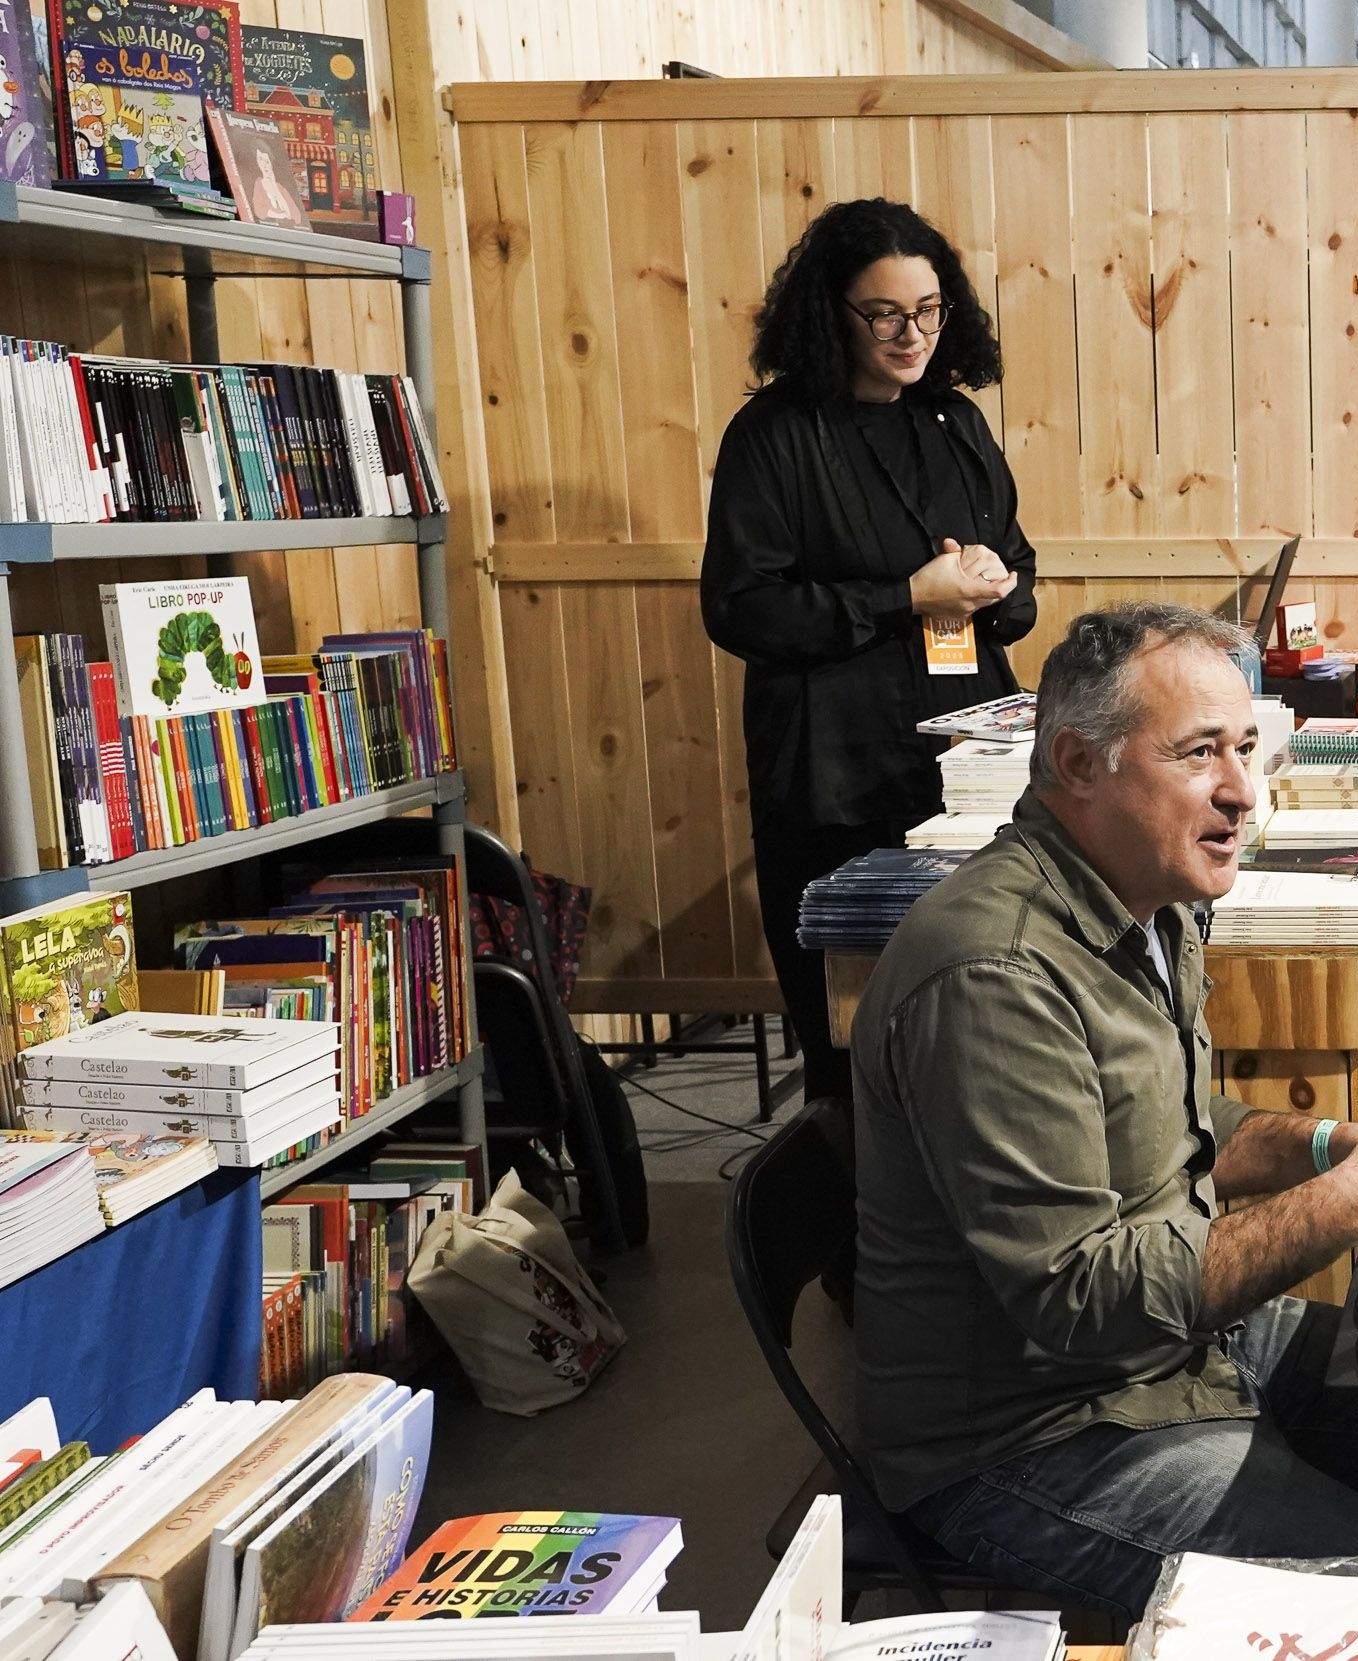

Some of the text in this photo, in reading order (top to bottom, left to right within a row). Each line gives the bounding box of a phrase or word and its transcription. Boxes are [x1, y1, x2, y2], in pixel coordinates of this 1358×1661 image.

[98, 25, 205, 64] NADALARIO
[95, 48, 193, 89] os bolechas
[148, 591, 224, 609] LIBRO POP-UP
[937, 629, 961, 640] GAL
[21, 926, 76, 964] LELA
[80, 1059, 128, 1074] Castelao
[78, 1085, 126, 1100] Castelao
[80, 1112, 129, 1127] Castelao
[165, 1517, 192, 1532] O
[185, 1480, 236, 1515] Tombo
[241, 1436, 288, 1472] Samos
[501, 1525, 598, 1535] CARLOS CALLÓN
[416, 1550, 622, 1584] VIDAS
[383, 1589, 595, 1606] E HISTORIAS
[876, 1639, 993, 1656] Incidencia
